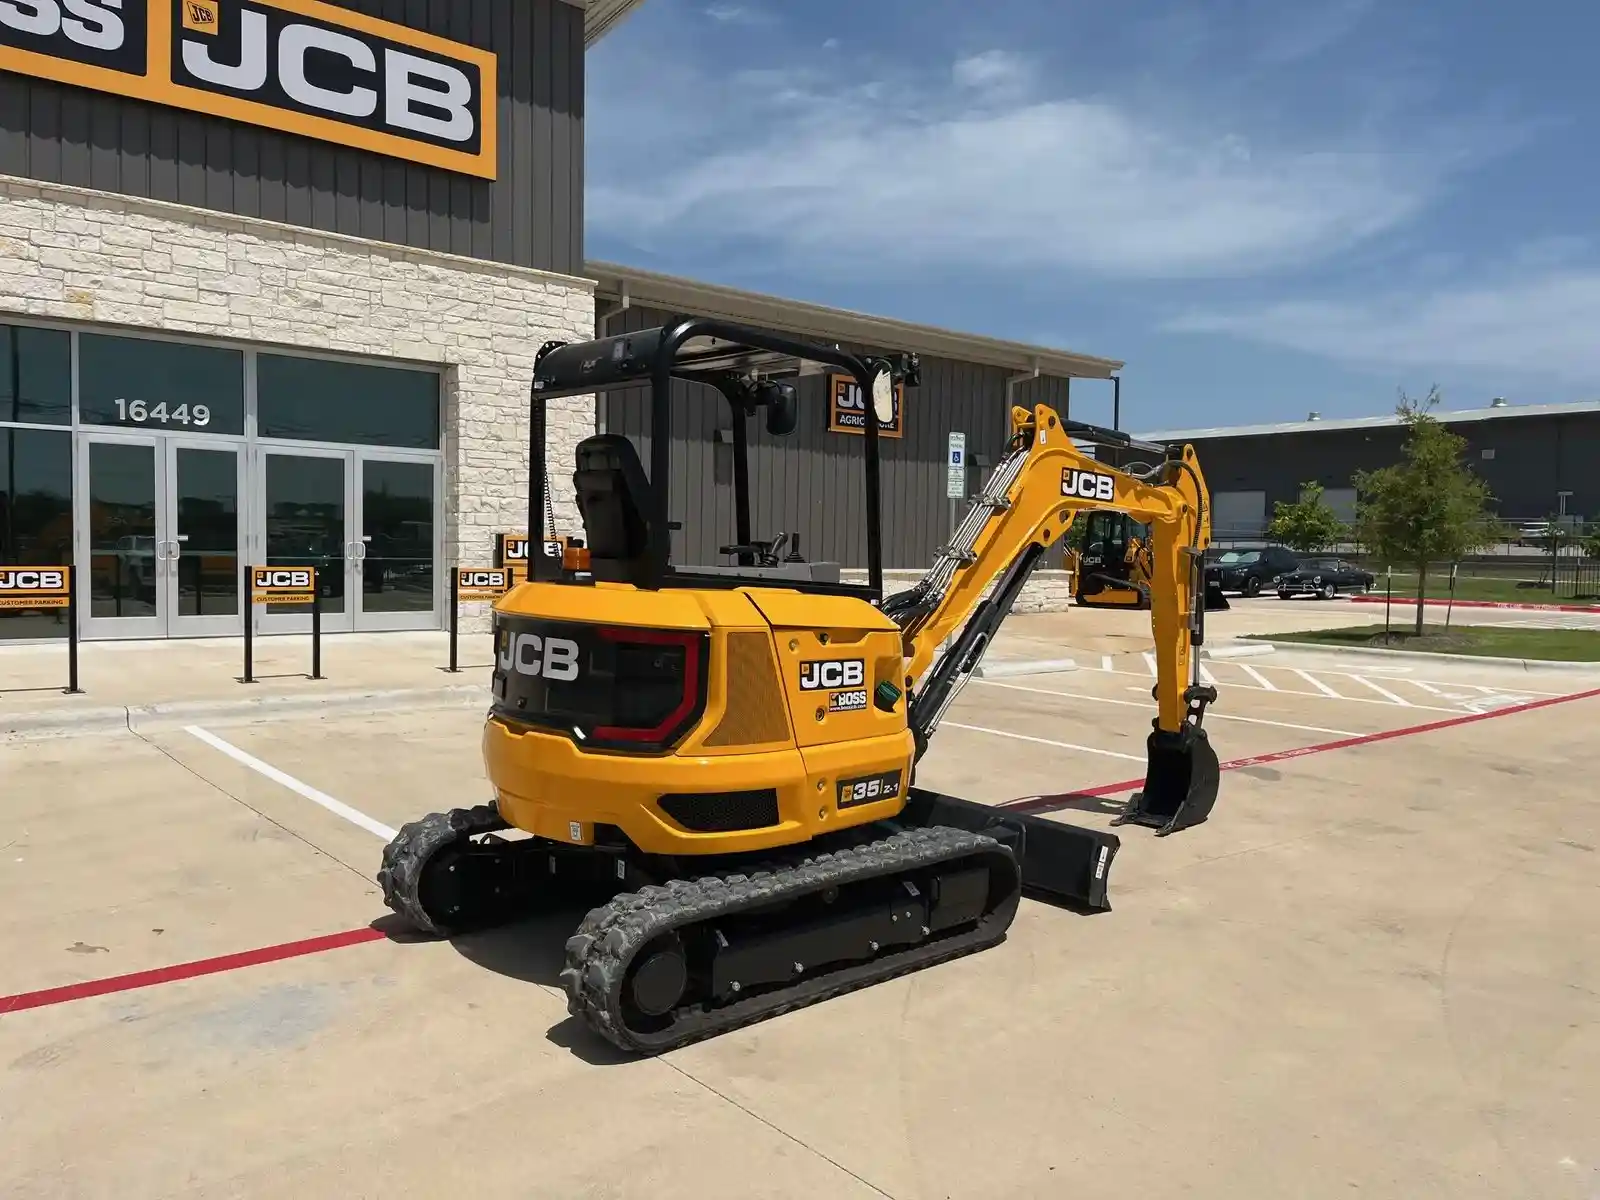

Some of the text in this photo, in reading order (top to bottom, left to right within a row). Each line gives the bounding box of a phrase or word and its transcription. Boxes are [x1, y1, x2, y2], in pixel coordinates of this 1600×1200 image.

[182, 10, 474, 142] JCB
[114, 398, 211, 426] 16449
[1062, 471, 1114, 500] JCB
[256, 571, 309, 586] JCB
[461, 572, 504, 586] JCB
[500, 631, 579, 681] JCB
[801, 661, 863, 688] JCB
[838, 691, 866, 706] BOSS
[853, 780, 880, 800] 35
